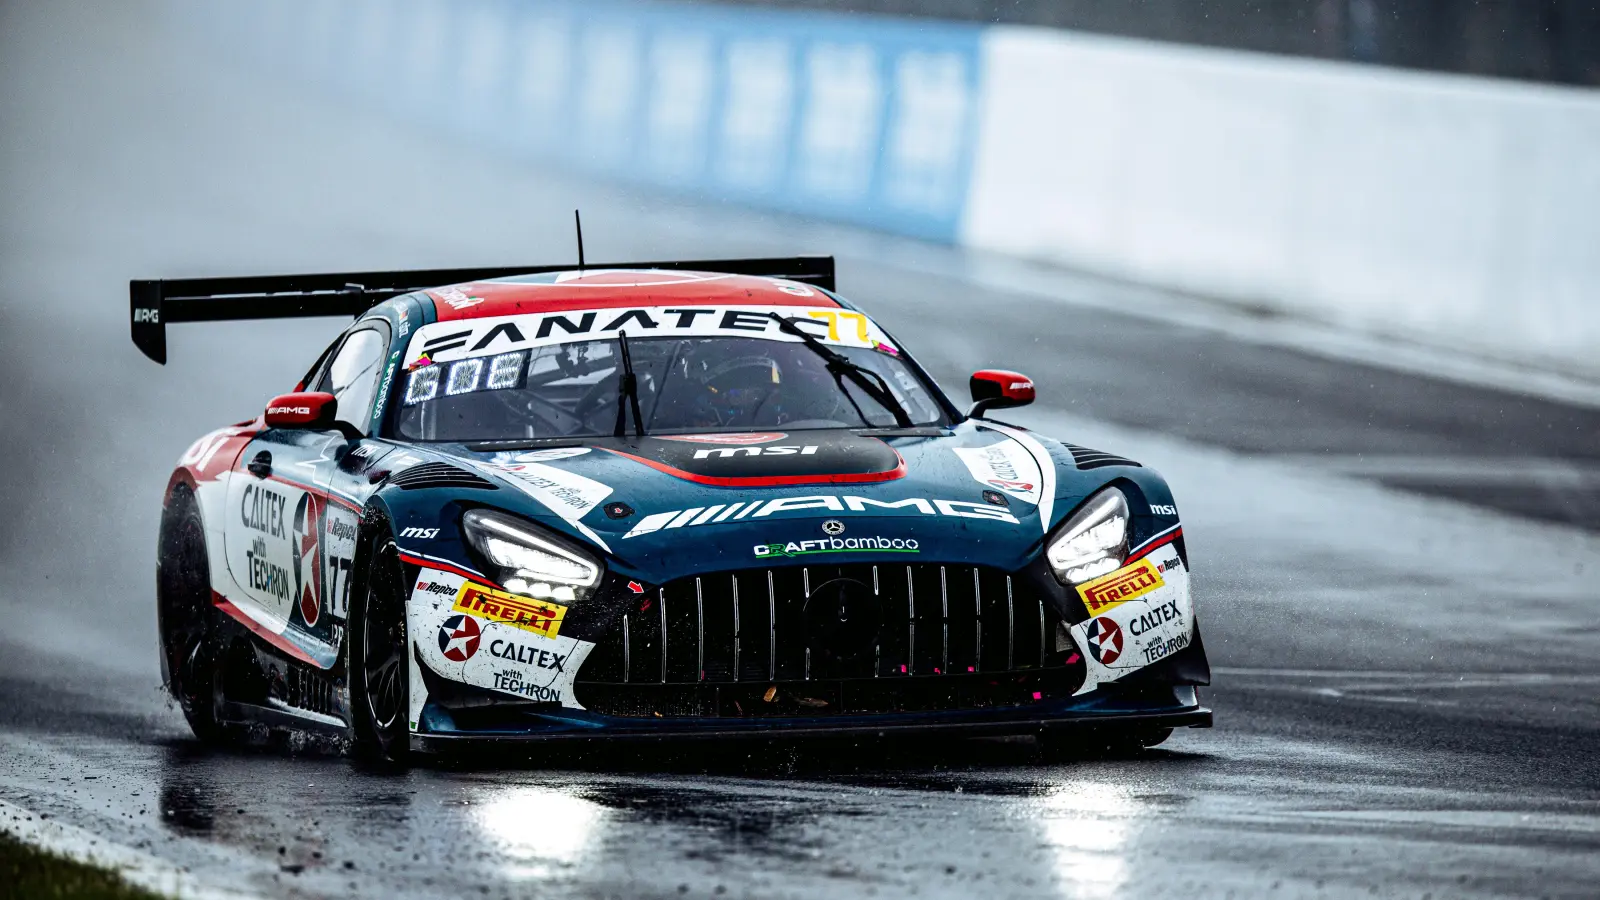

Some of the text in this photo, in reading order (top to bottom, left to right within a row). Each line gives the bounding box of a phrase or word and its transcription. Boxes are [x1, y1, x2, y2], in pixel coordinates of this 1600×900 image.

[140, 308, 159, 323] AMG
[807, 310, 870, 342] 77
[421, 307, 832, 363] FANATEC
[277, 406, 310, 415] AMG
[693, 445, 819, 459] msi
[241, 484, 286, 540] CALTEX
[751, 494, 1021, 526] AMG
[1150, 504, 1177, 515] msi
[252, 535, 267, 557] with
[399, 526, 440, 539] msi
[246, 550, 290, 605] TECHRON
[1163, 554, 1181, 571] Repco
[329, 555, 352, 616] 77
[426, 581, 458, 597] Repco
[1083, 565, 1158, 611] PIRELLI
[459, 587, 557, 633] PIRELLI
[1129, 599, 1182, 637] CALTEX
[489, 639, 567, 673] CALTEX
[1142, 632, 1189, 664] TECHRON
[1147, 635, 1163, 648] with
[493, 672, 561, 702] TECHRON
[502, 668, 523, 680] with
